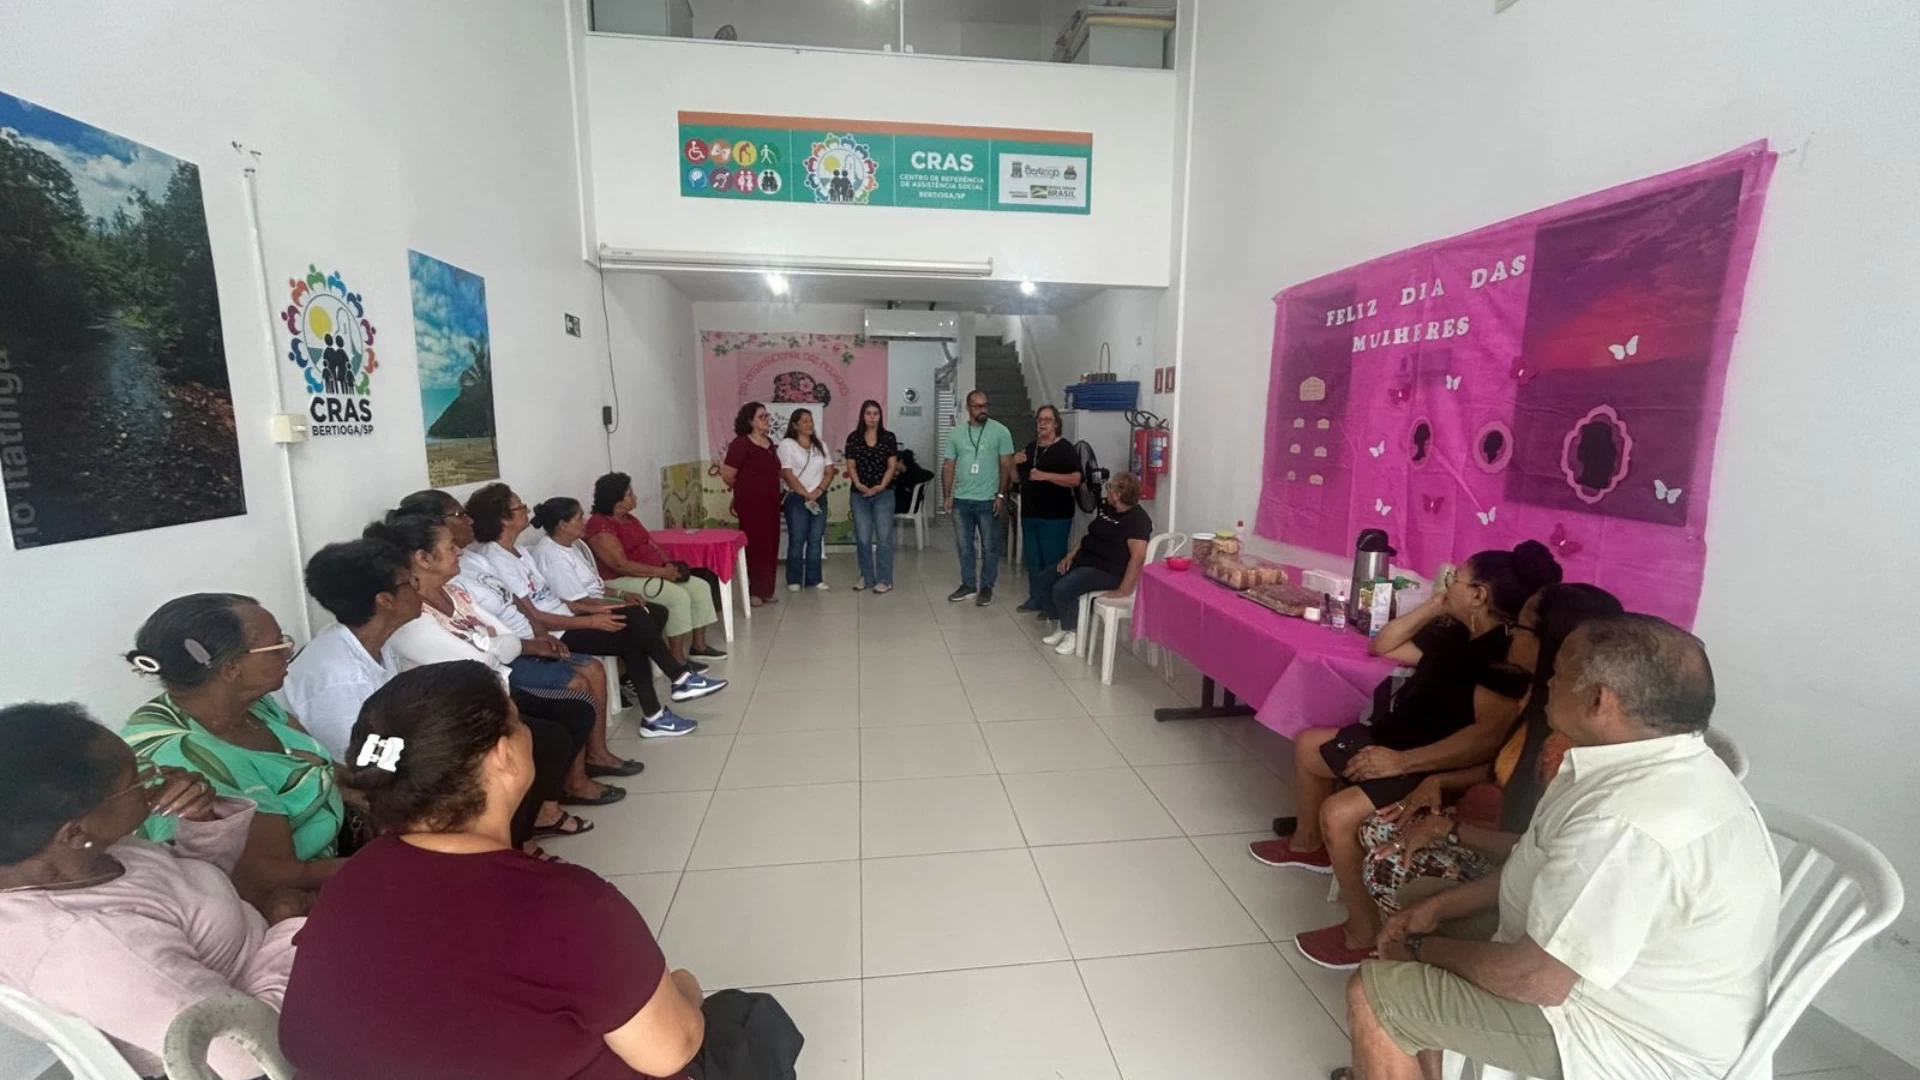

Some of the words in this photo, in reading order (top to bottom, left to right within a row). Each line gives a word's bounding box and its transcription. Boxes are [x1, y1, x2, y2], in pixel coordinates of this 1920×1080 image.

[911, 150, 974, 172] CRAS
[899, 173, 929, 181] CENTRO
[900, 180, 910, 188] DE
[957, 182, 984, 191] SOCIAL
[1046, 188, 1077, 198] BRASIL
[1325, 299, 1378, 327] FELIZ
[1400, 277, 1445, 306] DIA
[1469, 254, 1527, 289] DAS
[1352, 315, 1470, 353] MULHERES
[309, 396, 373, 423] CRAS
[311, 424, 375, 437] BERTIOGA/SP
